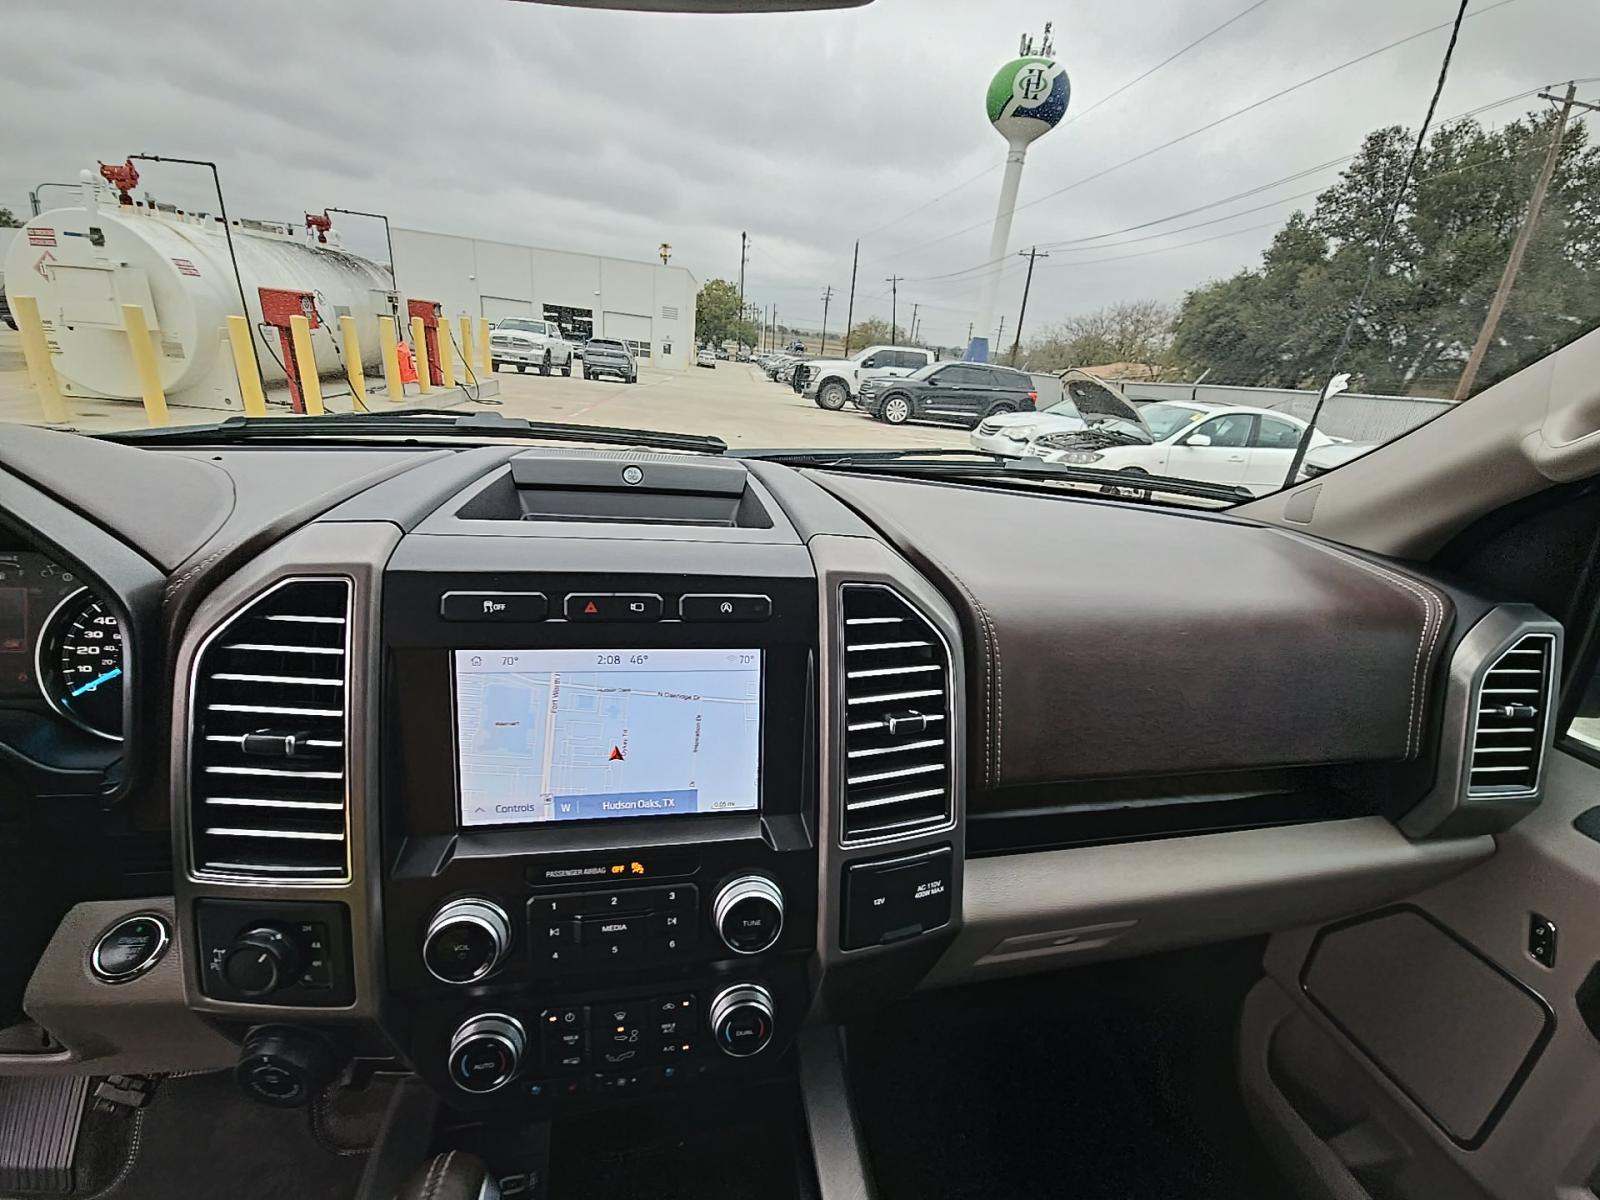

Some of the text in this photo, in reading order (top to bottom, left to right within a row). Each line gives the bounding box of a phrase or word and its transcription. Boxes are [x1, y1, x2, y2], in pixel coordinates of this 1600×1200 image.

[93, 616, 117, 625] 40
[84, 631, 104, 639] 30
[77, 646, 100, 655] 20
[597, 655, 649, 665] 2:08 46°
[77, 665, 92, 673] 10
[495, 803, 535, 814] Controls
[561, 803, 571, 812] W
[602, 798, 675, 810] Hudson Oaks, TX
[545, 865, 625, 878] PASSENGER AIRBAG OFF
[611, 896, 618, 905] 2
[668, 892, 676, 900] 3
[551, 902, 557, 911] 1
[601, 924, 627, 932] MEDIA
[669, 940, 676, 948] 6
[611, 945, 618, 954] 5
